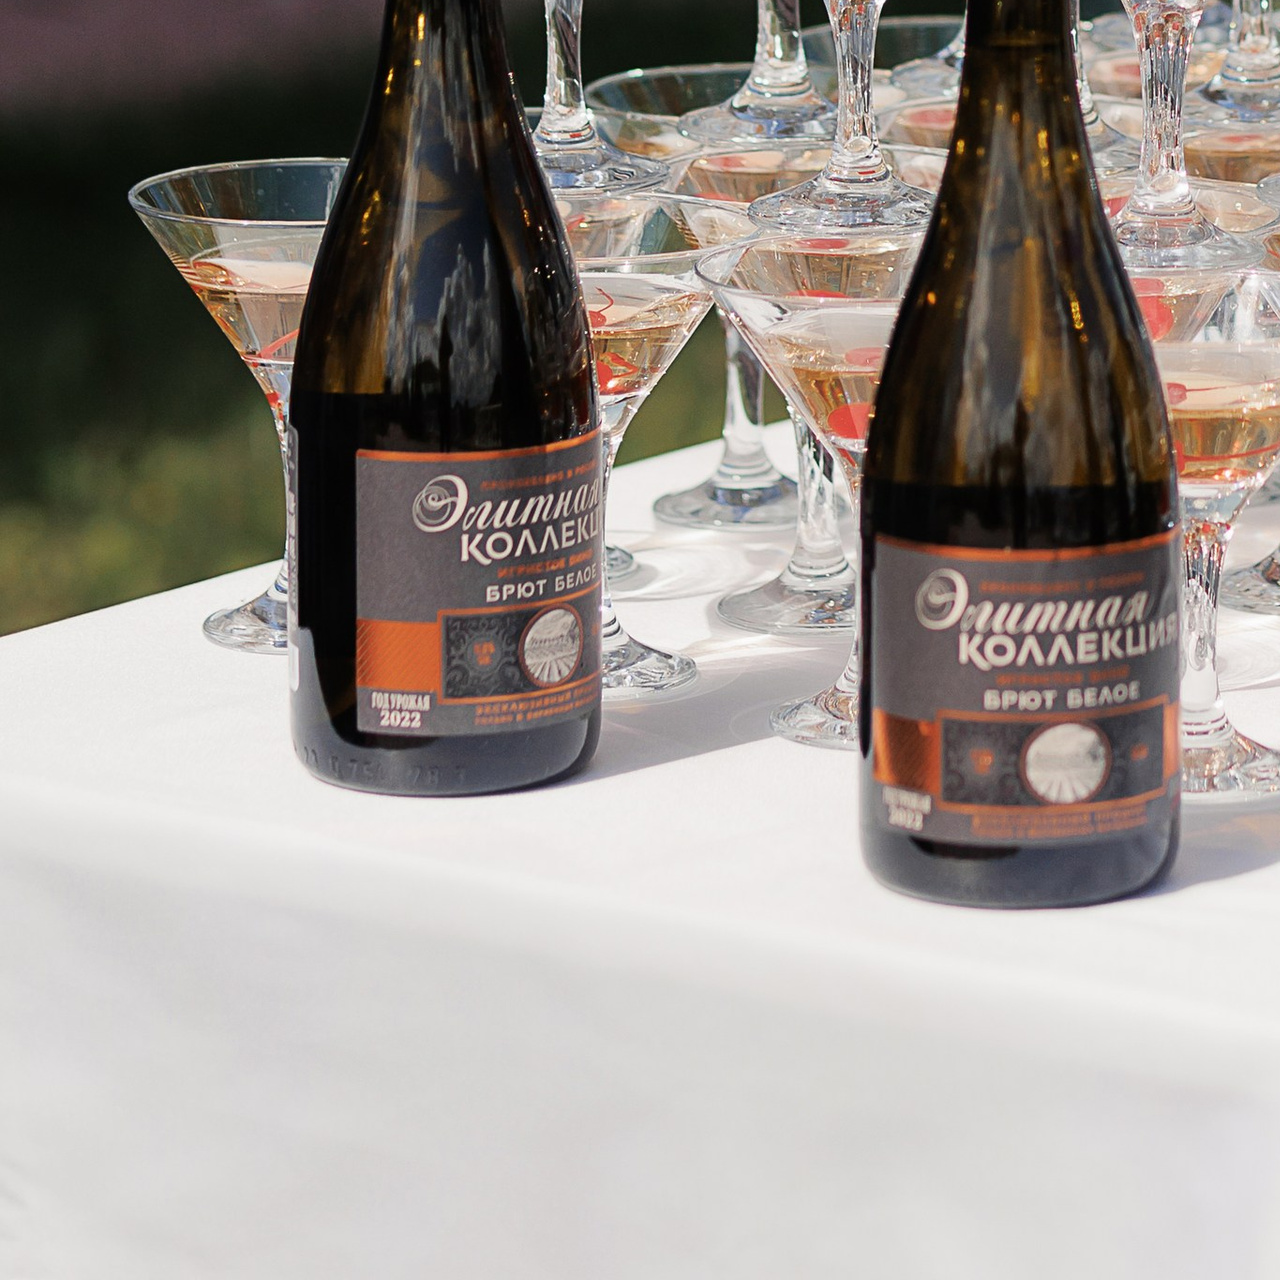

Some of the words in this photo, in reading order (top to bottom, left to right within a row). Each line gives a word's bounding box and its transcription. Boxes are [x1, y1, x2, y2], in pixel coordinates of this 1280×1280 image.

[411, 474, 600, 534] Элитная
[486, 578, 547, 603] БРЮТ
[554, 563, 597, 593] БЕЛОЕ
[915, 567, 1150, 634] Элитная
[958, 611, 1178, 671] КОЛЛЕКЦИЯ
[371, 690, 390, 710] ГОД
[390, 692, 431, 712] УРОЖАЯ
[984, 688, 1057, 711] БРЮТ
[1067, 681, 1140, 709] БЕЛОЕ
[379, 710, 422, 729] 2022
